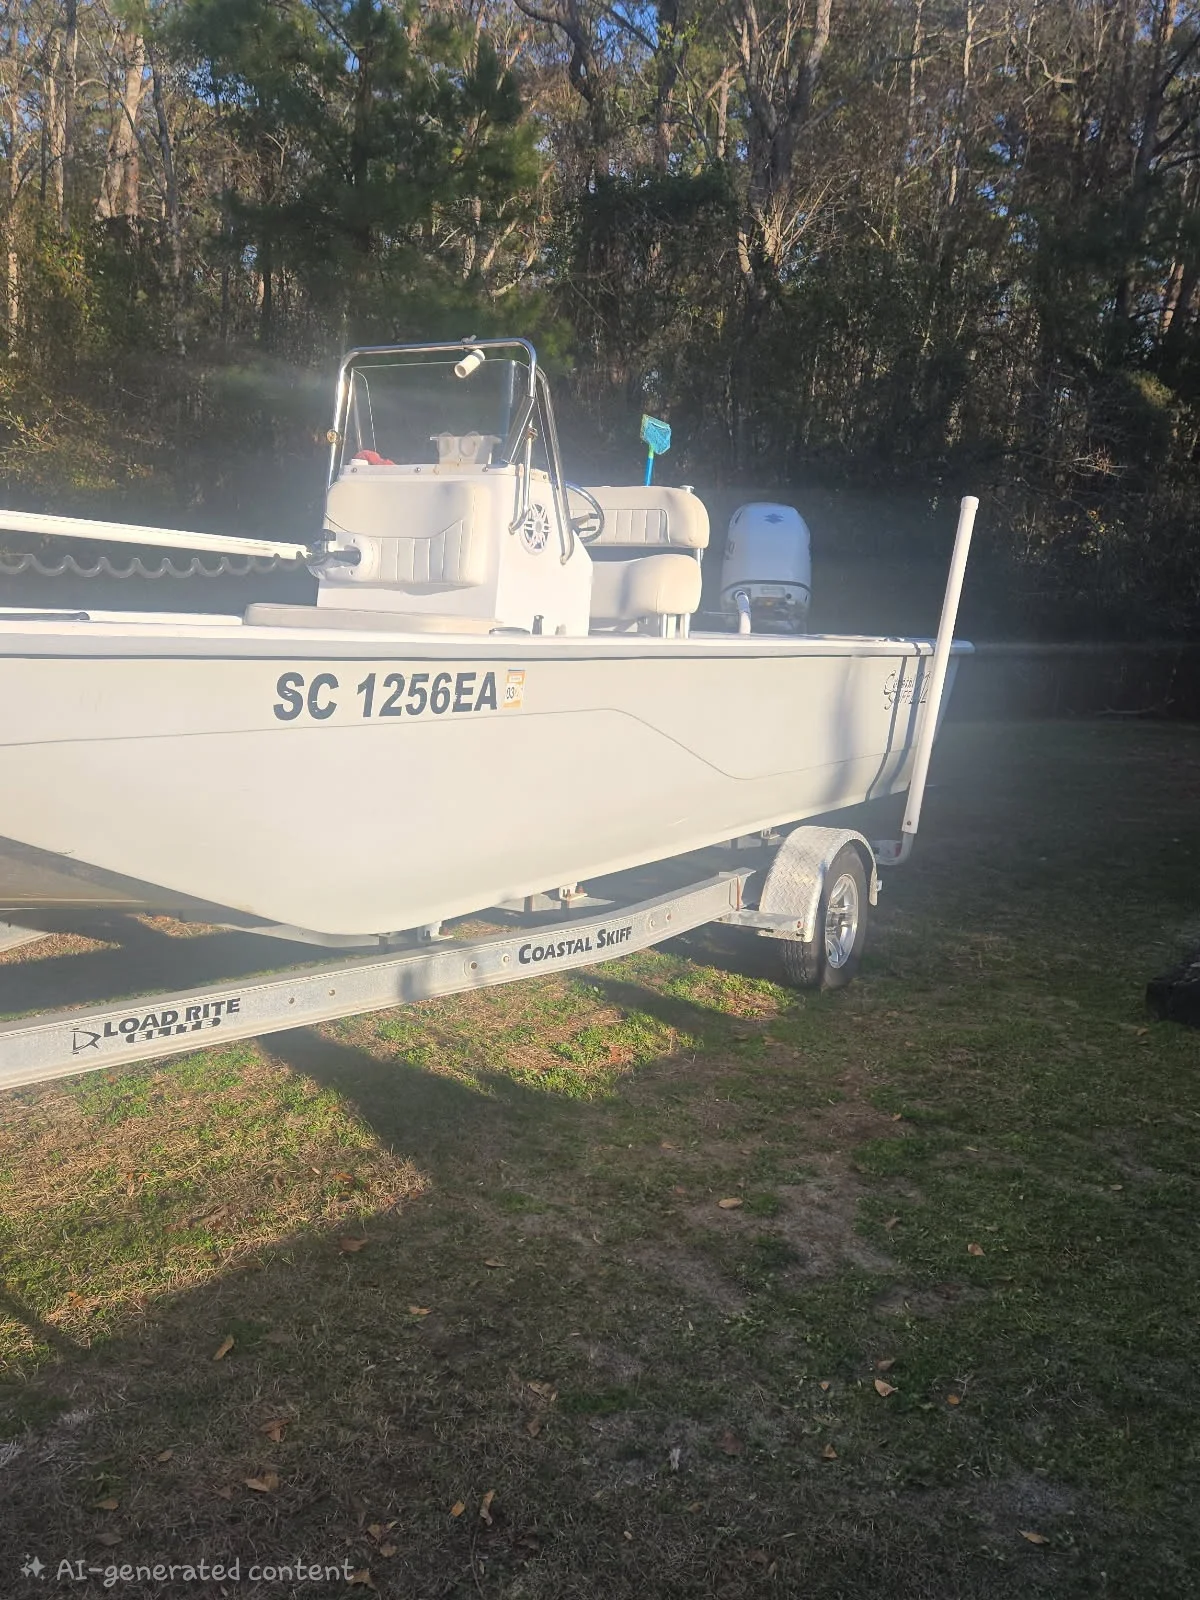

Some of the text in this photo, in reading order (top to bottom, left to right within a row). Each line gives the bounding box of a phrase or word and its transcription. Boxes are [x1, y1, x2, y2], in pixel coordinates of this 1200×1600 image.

[273, 671, 497, 721] SC 1256EA
[518, 926, 632, 964] COASTAL SKIFF
[103, 997, 241, 1038] LOAD RITE
